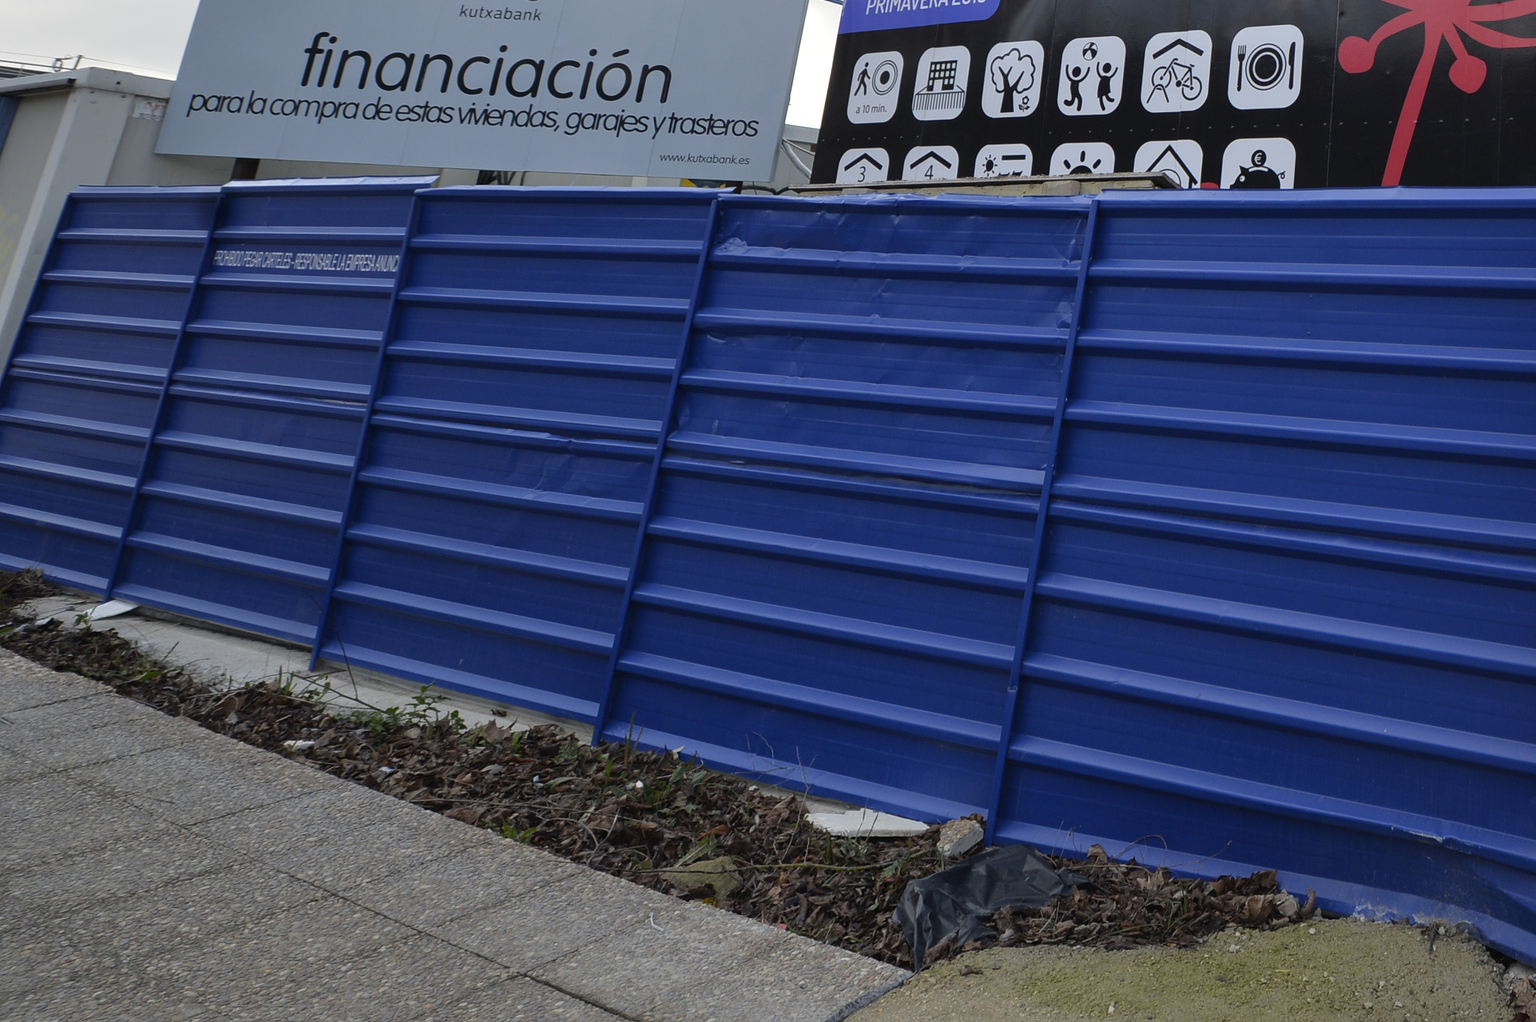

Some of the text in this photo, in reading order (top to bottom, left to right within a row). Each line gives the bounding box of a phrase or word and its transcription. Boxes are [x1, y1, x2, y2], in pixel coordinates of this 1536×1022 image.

[459, 5, 542, 21] kutxabank
[301, 31, 672, 104] financiación
[186, 93, 245, 117] para
[245, 90, 268, 115] la
[269, 97, 360, 124] compra
[362, 97, 393, 121] de
[395, 101, 455, 124] estas
[458, 102, 560, 132] viviendas,
[564, 109, 649, 138] garajes
[651, 116, 667, 139] y
[667, 112, 760, 137] trasteros
[856, 104, 888, 114] a 10 min.
[659, 153, 751, 166] www.kutxabank.es
[923, 164, 934, 180] 4
